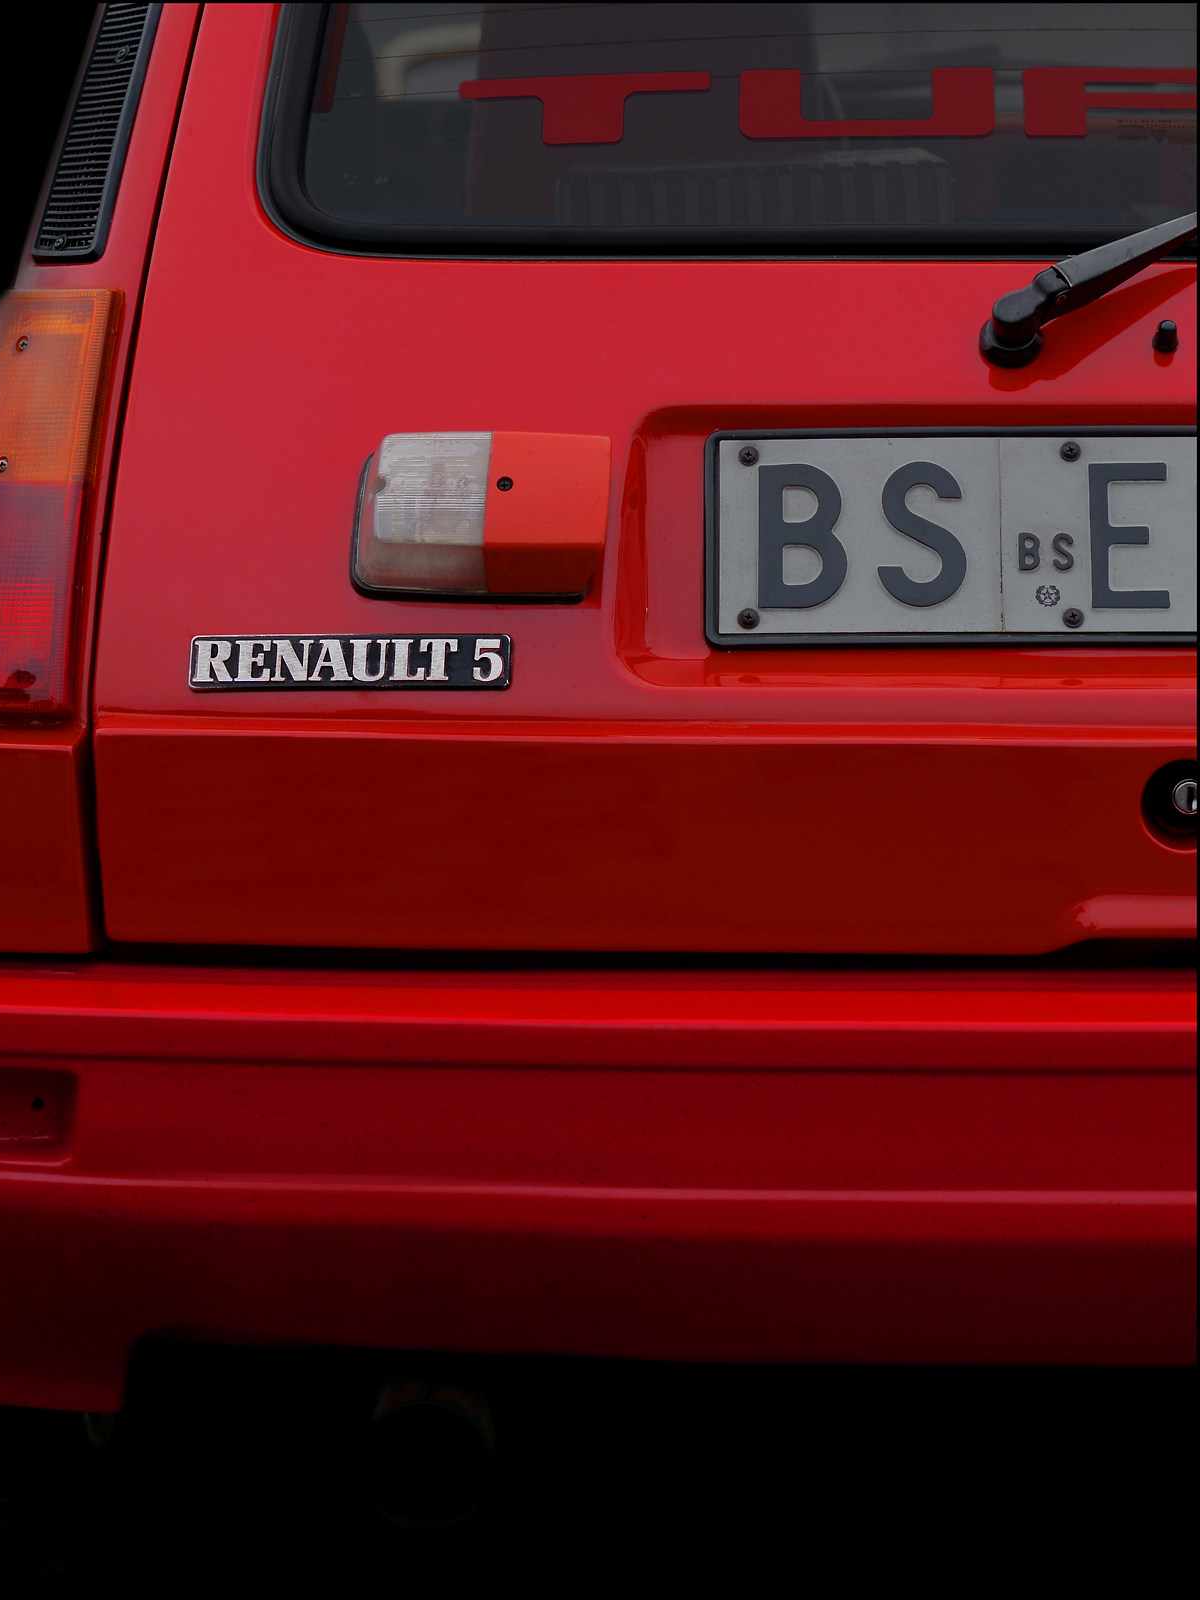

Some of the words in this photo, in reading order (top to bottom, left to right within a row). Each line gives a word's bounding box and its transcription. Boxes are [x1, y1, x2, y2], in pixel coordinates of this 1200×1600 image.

[757, 461, 967, 608] BS
[1018, 532, 1074, 571] BS
[192, 638, 458, 682] RENAULT
[472, 638, 503, 682] 5
